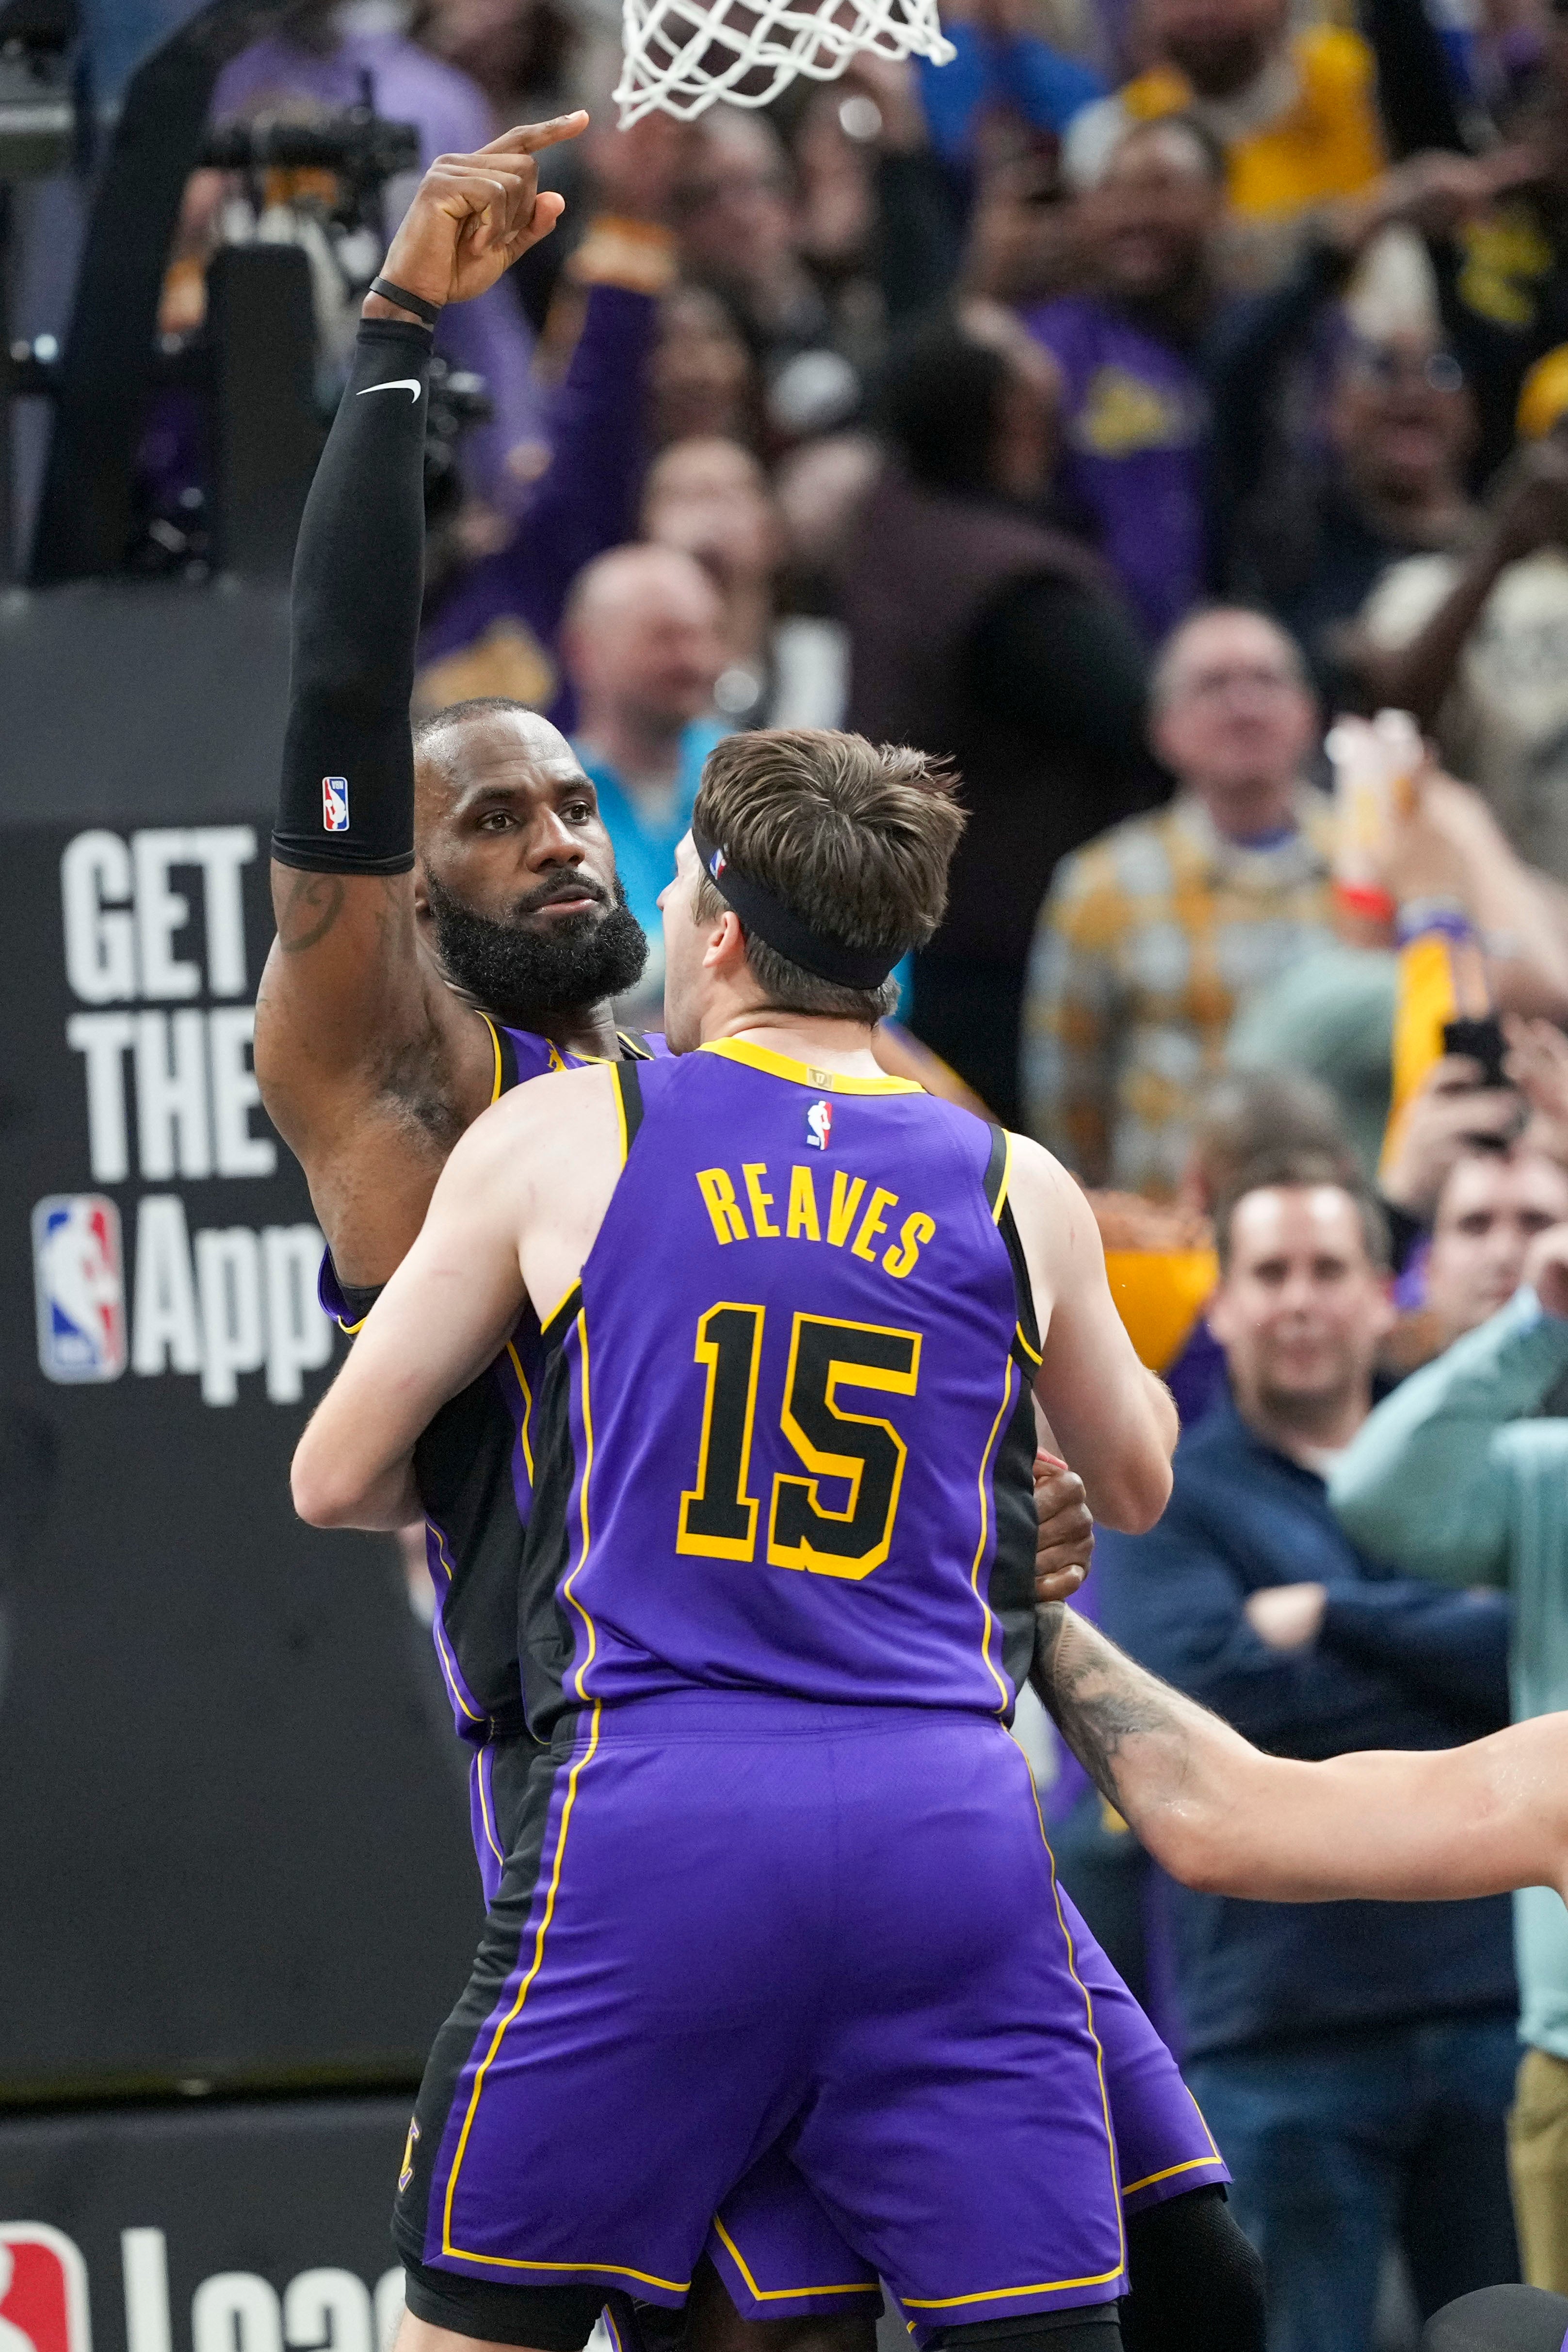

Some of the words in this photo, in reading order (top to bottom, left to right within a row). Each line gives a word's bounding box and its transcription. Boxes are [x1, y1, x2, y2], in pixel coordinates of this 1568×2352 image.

[61, 827, 257, 1003] GET
[65, 1007, 277, 1184] THE
[131, 1194, 333, 1406] App
[696, 1163, 935, 1278] REAVES
[676, 1301, 922, 1580] 15
